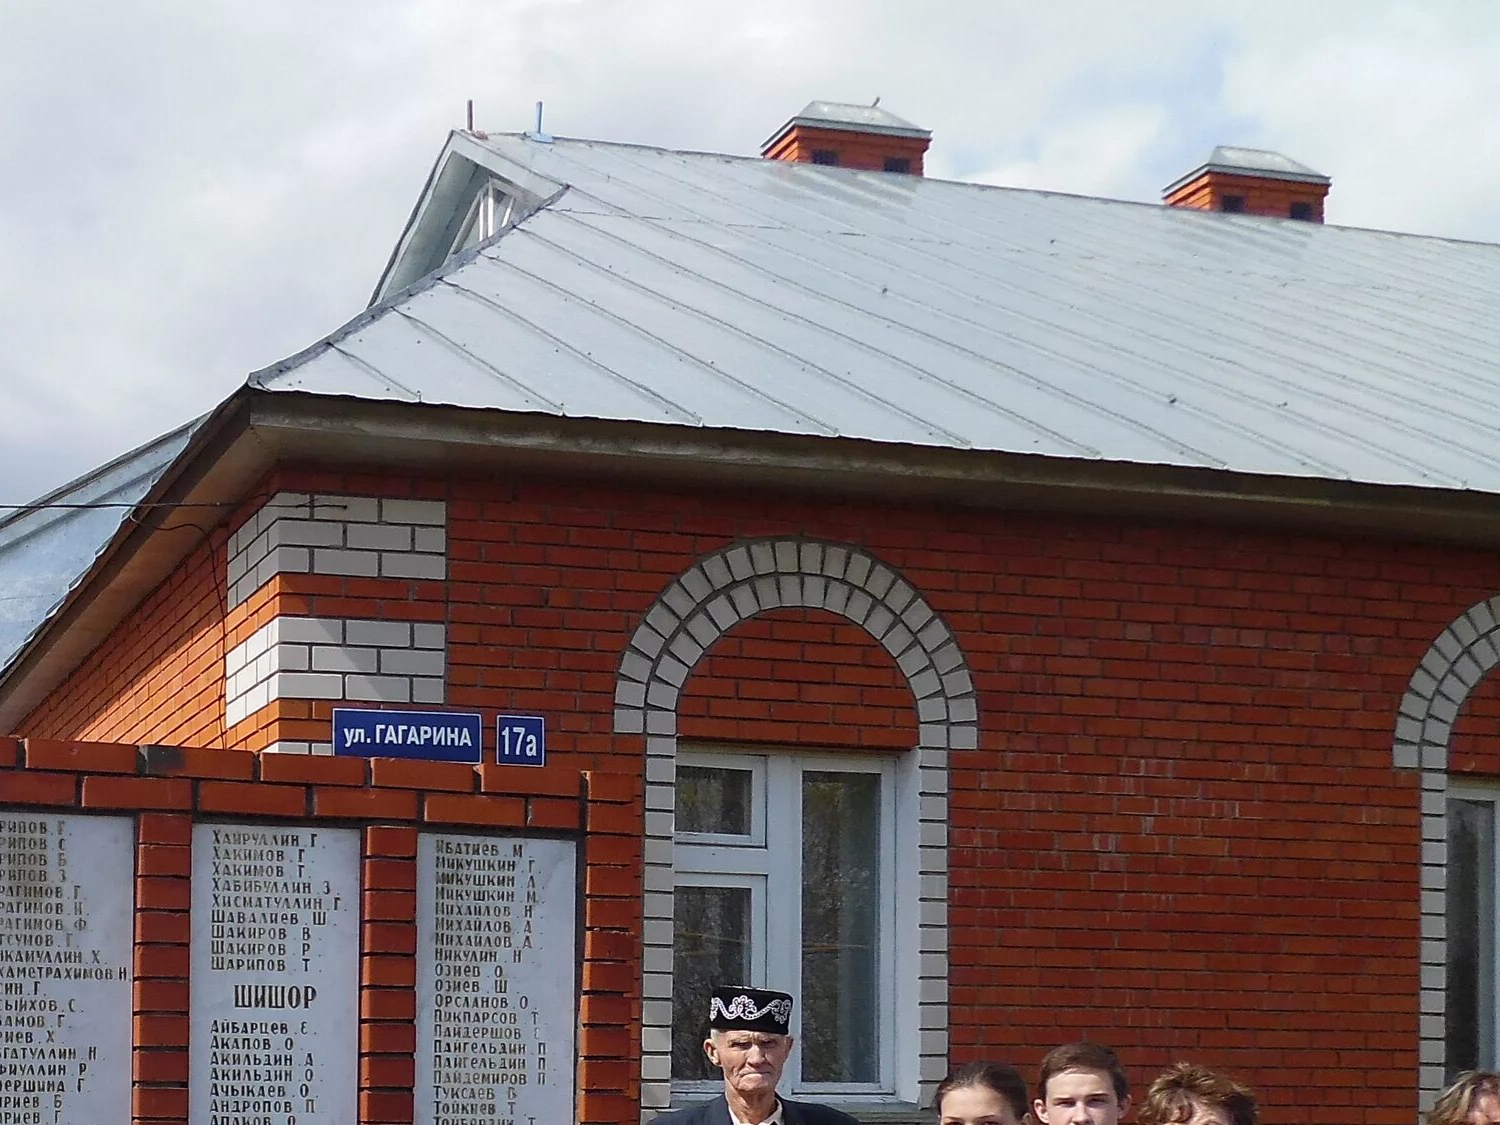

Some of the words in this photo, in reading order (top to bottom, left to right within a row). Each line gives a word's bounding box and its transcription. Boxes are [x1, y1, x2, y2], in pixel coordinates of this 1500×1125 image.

[343, 727, 371, 747] ул.
[375, 723, 472, 748] ГАГАРИНА
[501, 726, 537, 756] 17а
[234, 984, 316, 1009] ШИШОР
